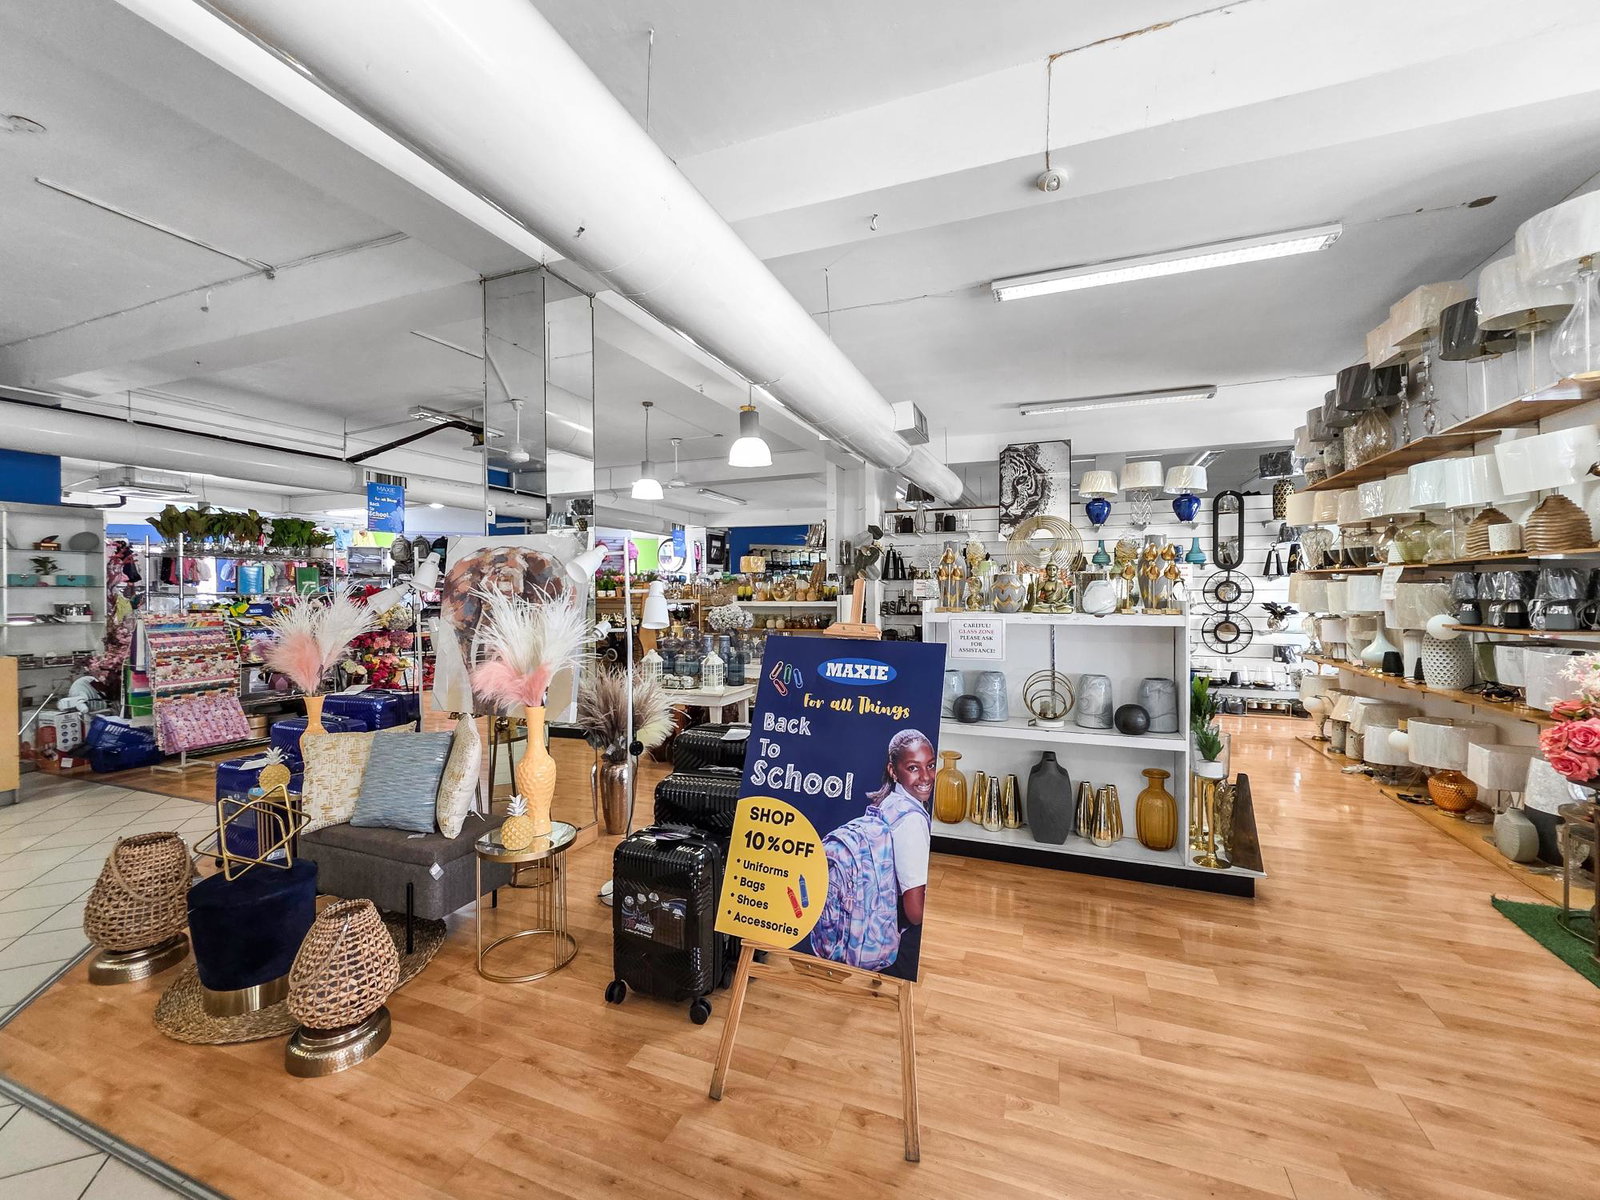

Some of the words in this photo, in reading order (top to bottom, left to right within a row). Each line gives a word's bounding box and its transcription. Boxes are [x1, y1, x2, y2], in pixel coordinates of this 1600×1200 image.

[825, 662, 889, 681] MAXIE
[803, 692, 825, 709] For
[829, 697, 854, 713] all
[857, 695, 910, 720] Things
[763, 712, 812, 736] Back
[759, 737, 781, 759] To
[750, 759, 854, 801] School
[750, 806, 795, 827] SHOP
[743, 859, 789, 878] Uniforms
[740, 876, 766, 893] Bags
[737, 893, 769, 910] Shoes
[733, 911, 799, 937] Accessories
